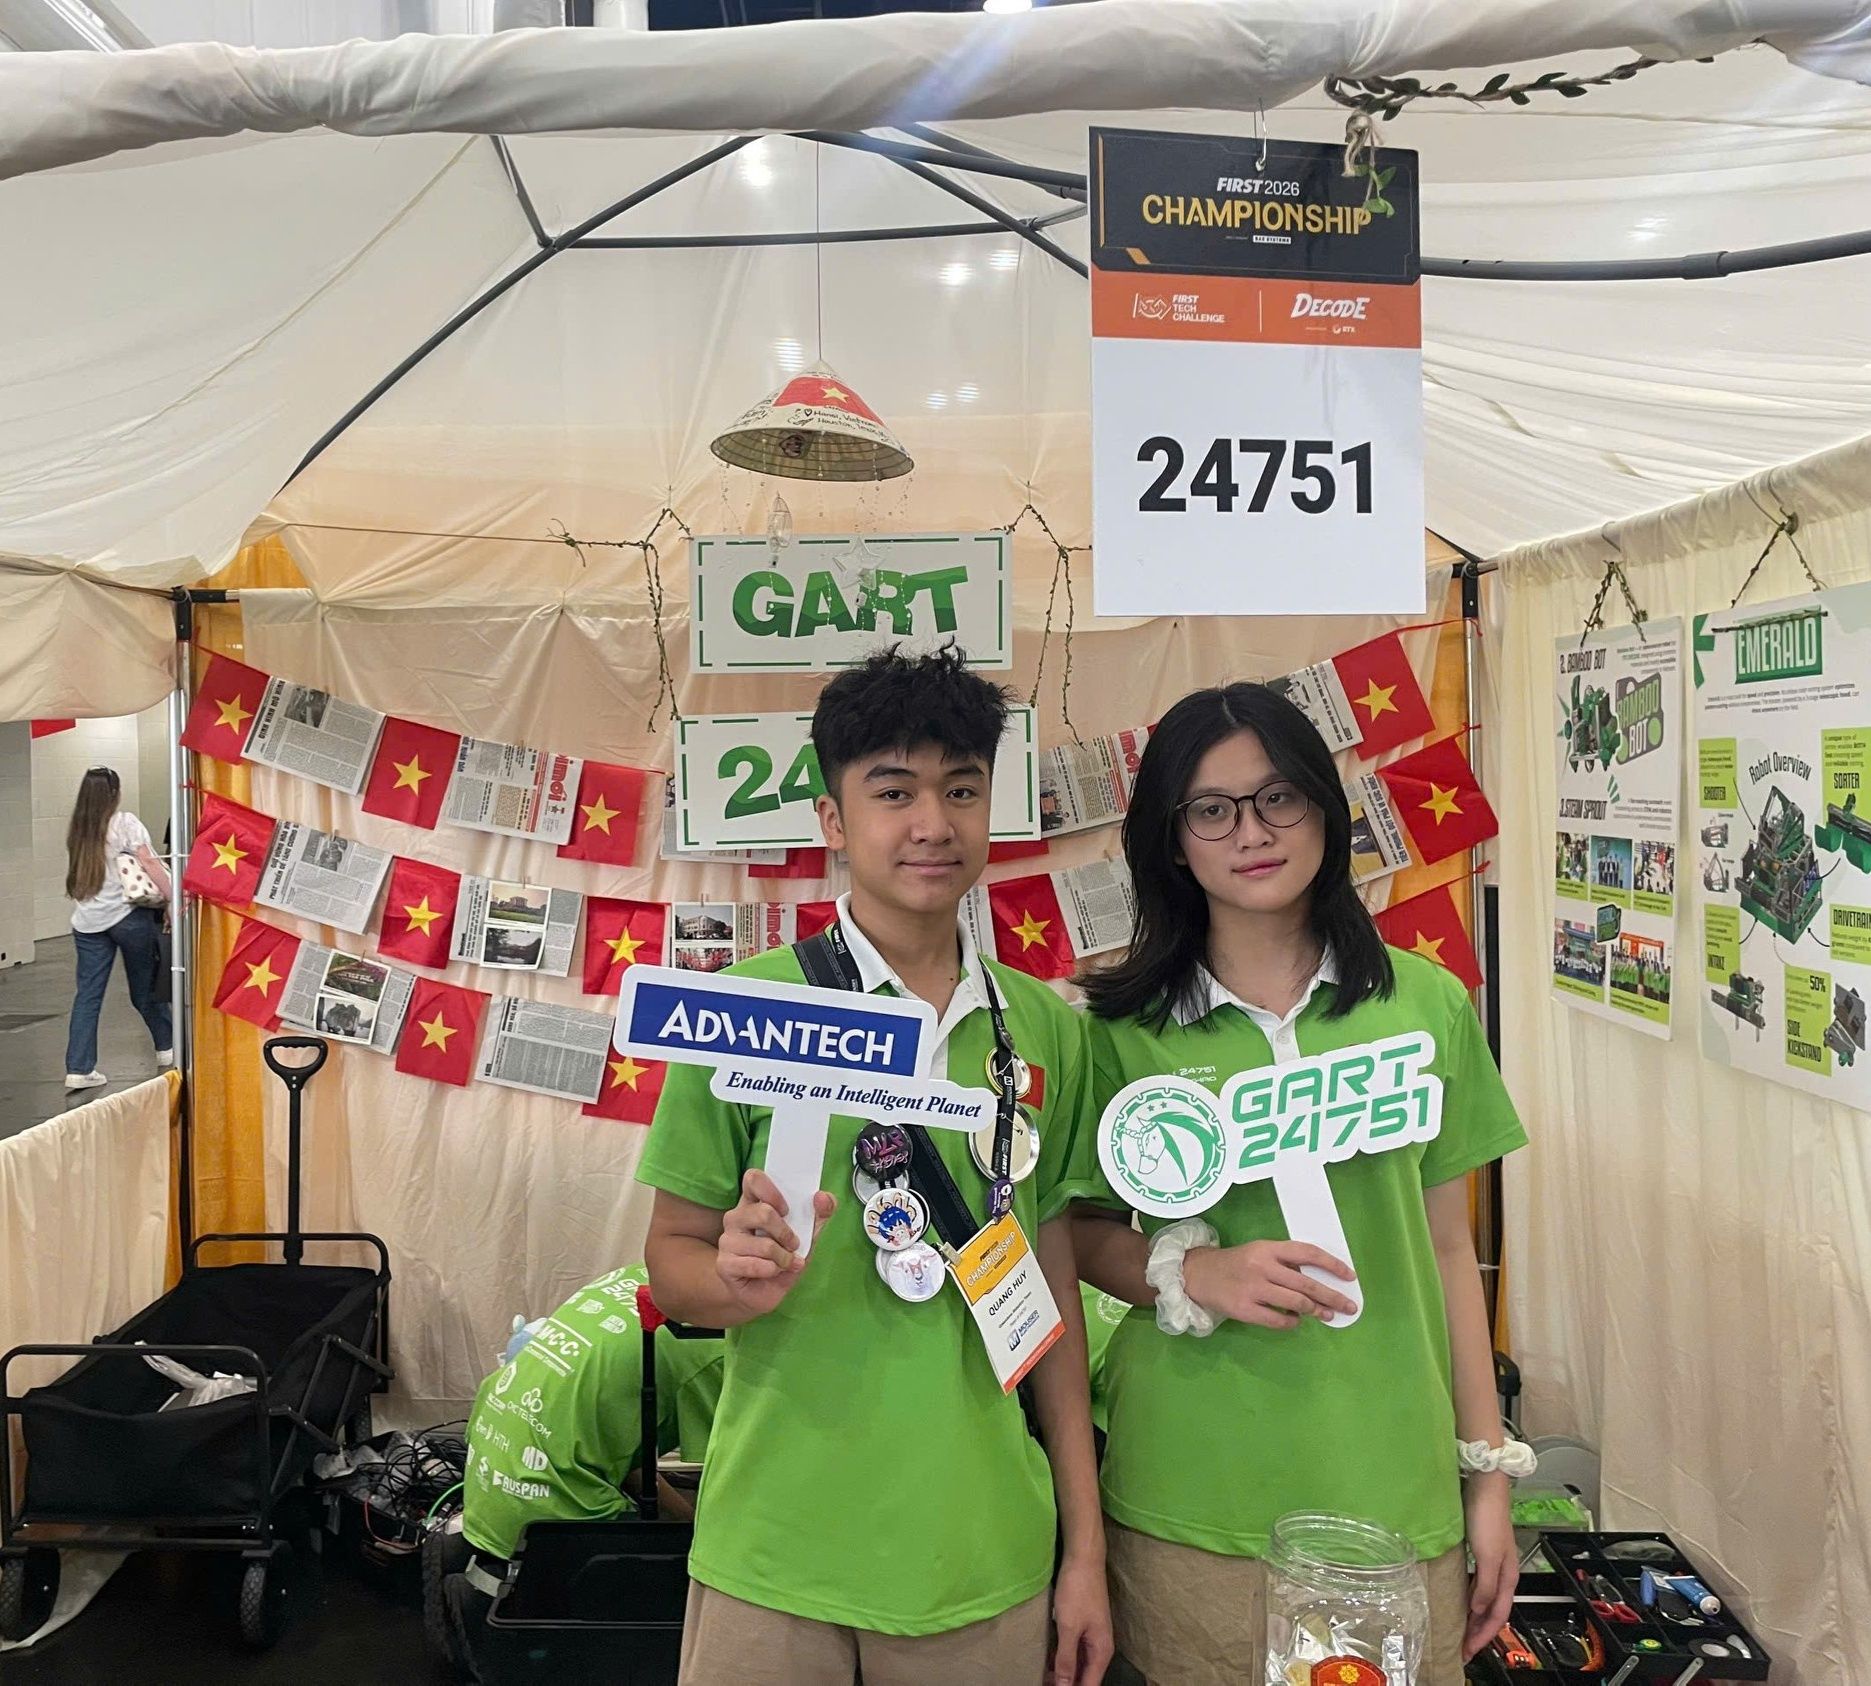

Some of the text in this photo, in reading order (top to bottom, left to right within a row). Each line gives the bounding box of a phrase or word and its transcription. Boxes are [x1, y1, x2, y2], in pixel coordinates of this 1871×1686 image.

[1217, 177, 1300, 197] FIRST 2026
[1142, 194, 1372, 235] CHAMPIONSHIP
[1172, 294, 1199, 303] FIRST
[1172, 303, 1198, 313] TECH
[1291, 292, 1370, 320] DECODE
[1172, 312, 1225, 323] CHALLENGE
[1137, 436, 1372, 514] 24751
[732, 566, 969, 639] GART
[1594, 648, 1606, 669] BOT
[1738, 617, 1817, 674] EMERALD
[1629, 718, 1649, 757] BOT
[1749, 754, 1772, 785] Robot
[1772, 751, 1812, 781] Overview
[1833, 772, 1860, 789] SORTER
[1809, 975, 1826, 992] 50%
[658, 1000, 894, 1066] ADVANTECH
[1787, 1038, 1822, 1062] KICKSTAND
[726, 1071, 807, 1099] Enabling
[811, 1085, 833, 1099] an
[836, 1084, 924, 1112] Intelligent
[925, 1096, 982, 1118] Planet
[1231, 1043, 1422, 1124] GART
[1238, 1086, 1430, 1169] 24751
[999, 1153, 1009, 1175] FIRST
[966, 1231, 1016, 1287] CHAMPIONSHIP
[989, 1270, 1028, 1316] QUANG HUY
[1019, 1309, 1039, 1333] MOUSER
